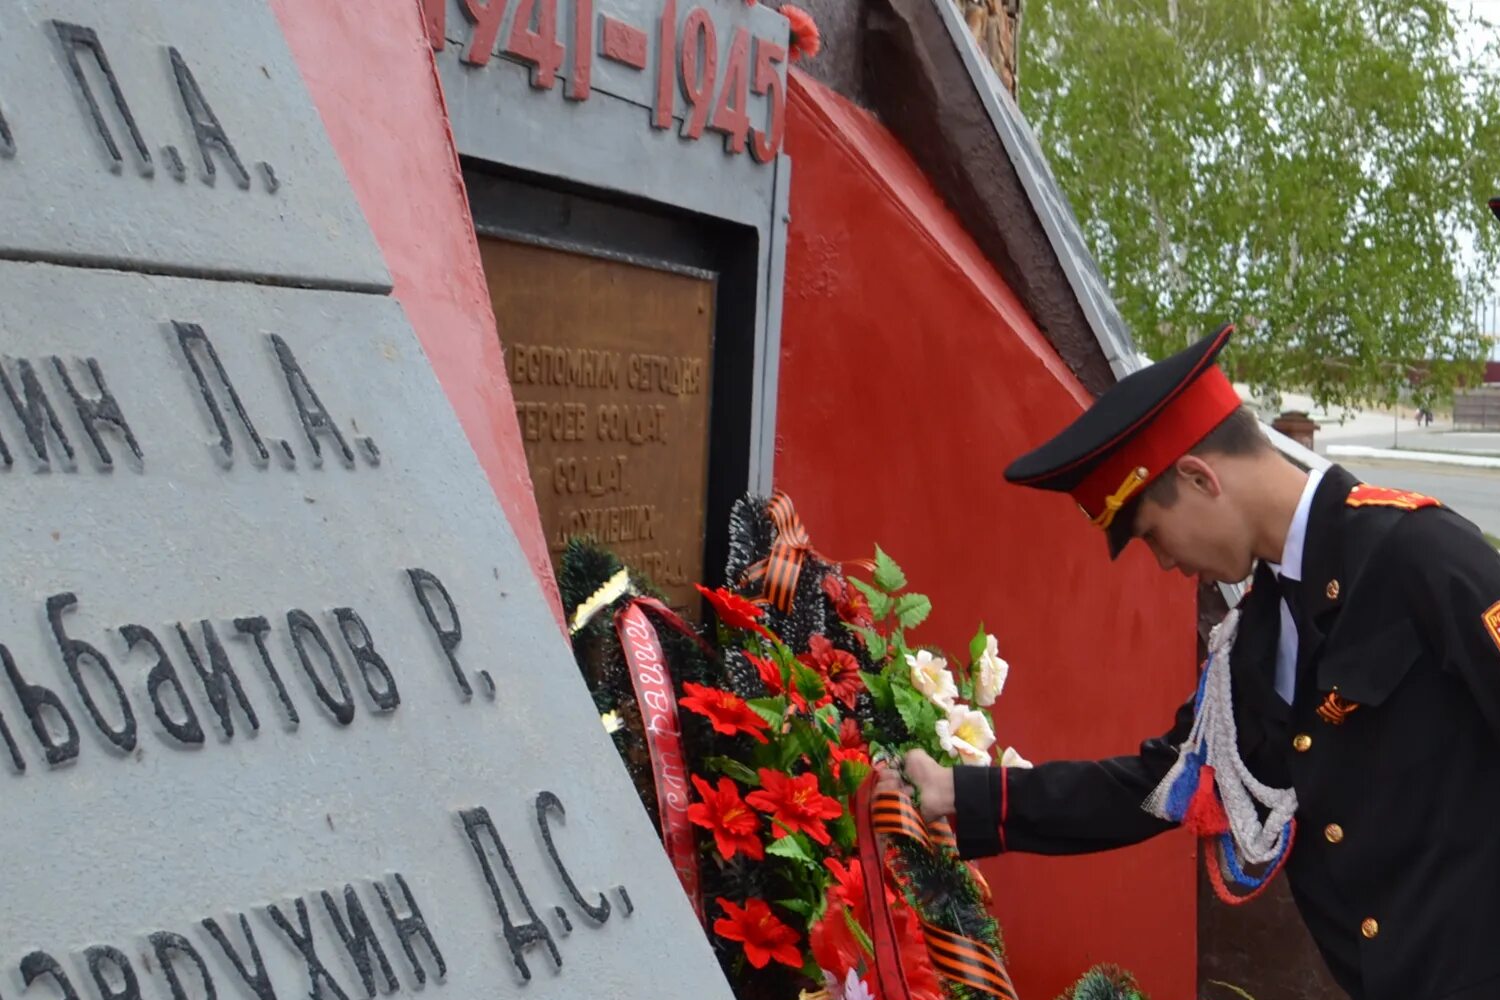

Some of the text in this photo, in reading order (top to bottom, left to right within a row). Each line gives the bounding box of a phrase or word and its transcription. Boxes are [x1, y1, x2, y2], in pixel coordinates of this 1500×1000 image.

[0, 353, 144, 472] ин
[513, 343, 702, 397] ВСПОМНИМ СЕГОДНЯ
[0, 590, 401, 771] ьбаитов
[459, 790, 634, 982] Д.С.
